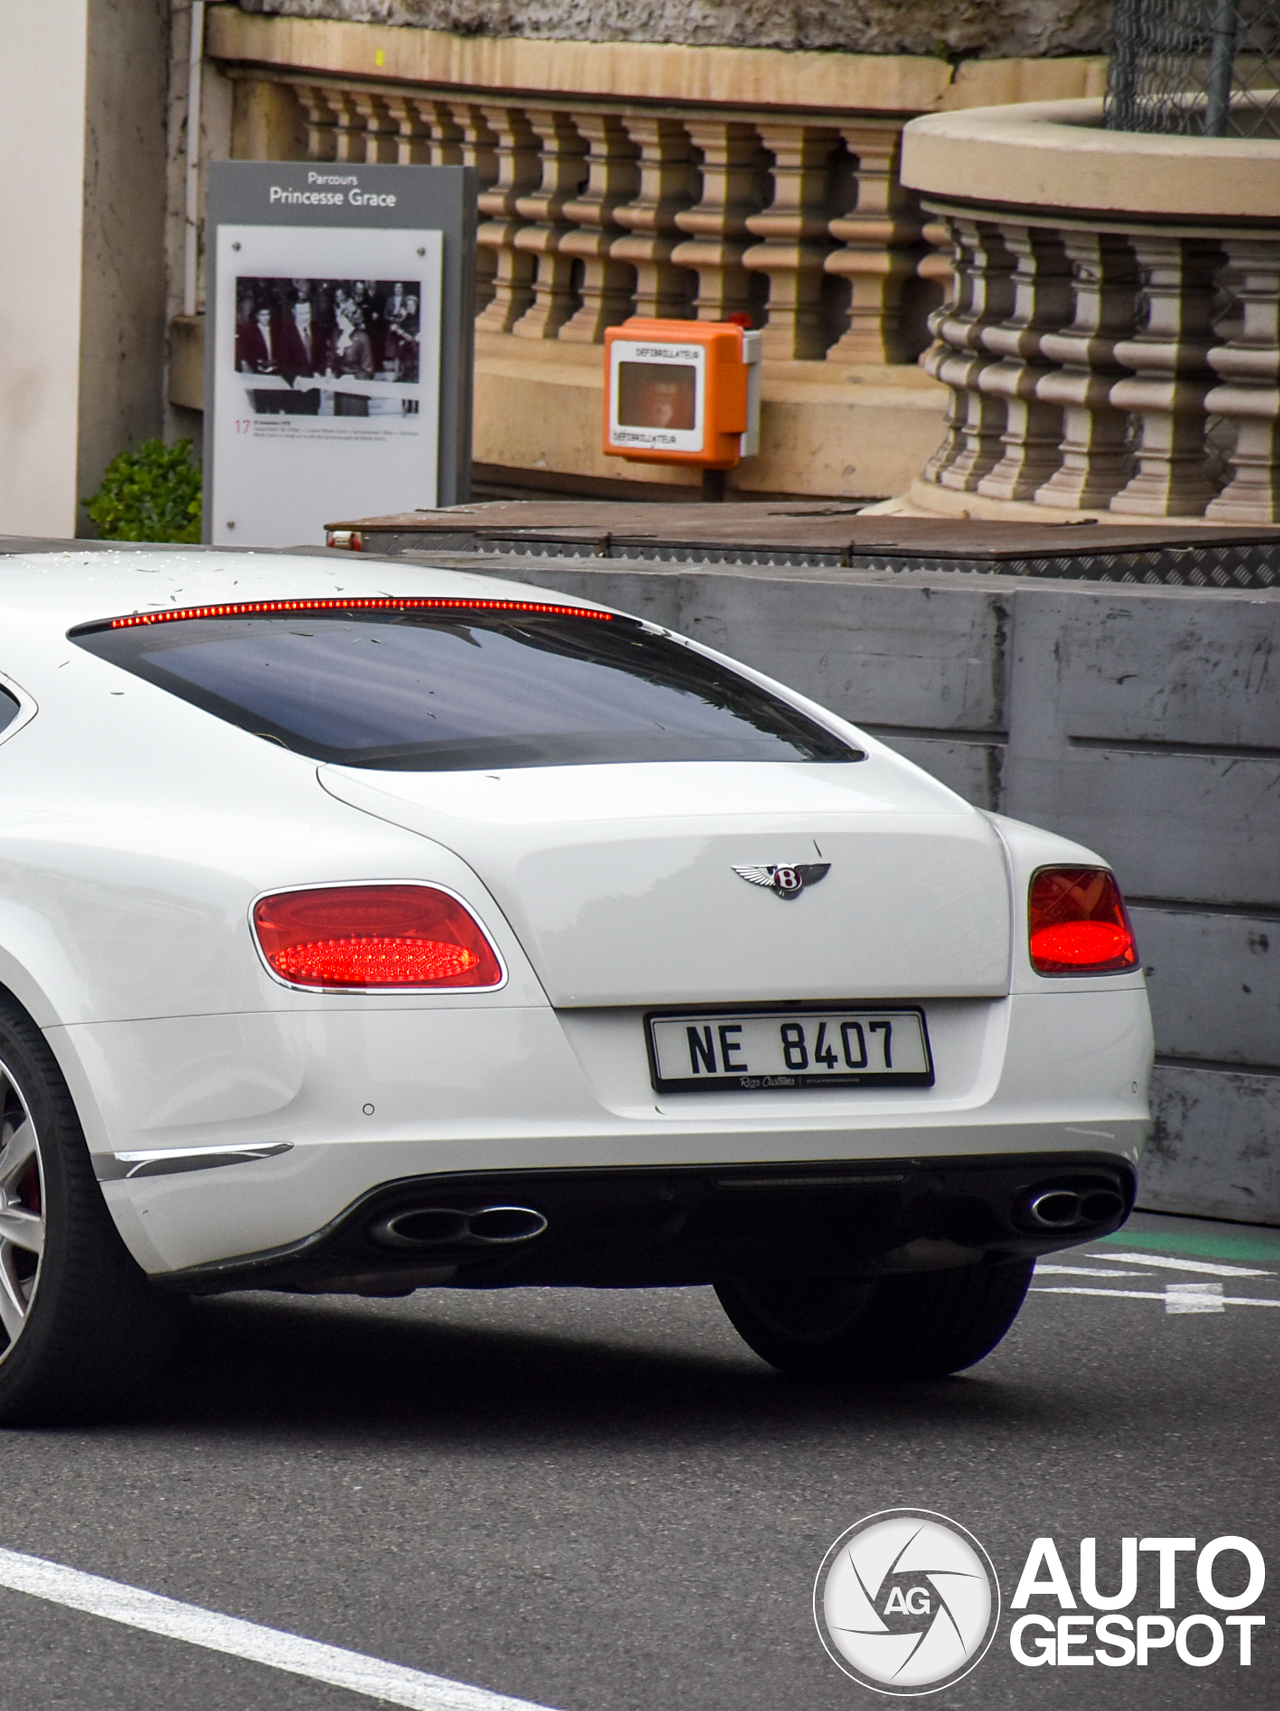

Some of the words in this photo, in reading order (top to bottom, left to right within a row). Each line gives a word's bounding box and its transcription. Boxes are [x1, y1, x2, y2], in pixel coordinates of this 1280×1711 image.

[308, 171, 358, 185] Parcours
[270, 186, 344, 205] Princesse
[348, 188, 397, 207] Grace
[235, 420, 251, 433] 17
[778, 869, 798, 889] B
[687, 1025, 748, 1074] NE
[780, 1021, 892, 1070] 8407
[740, 1077, 760, 1089] Riga
[762, 1076, 795, 1087] Customs
